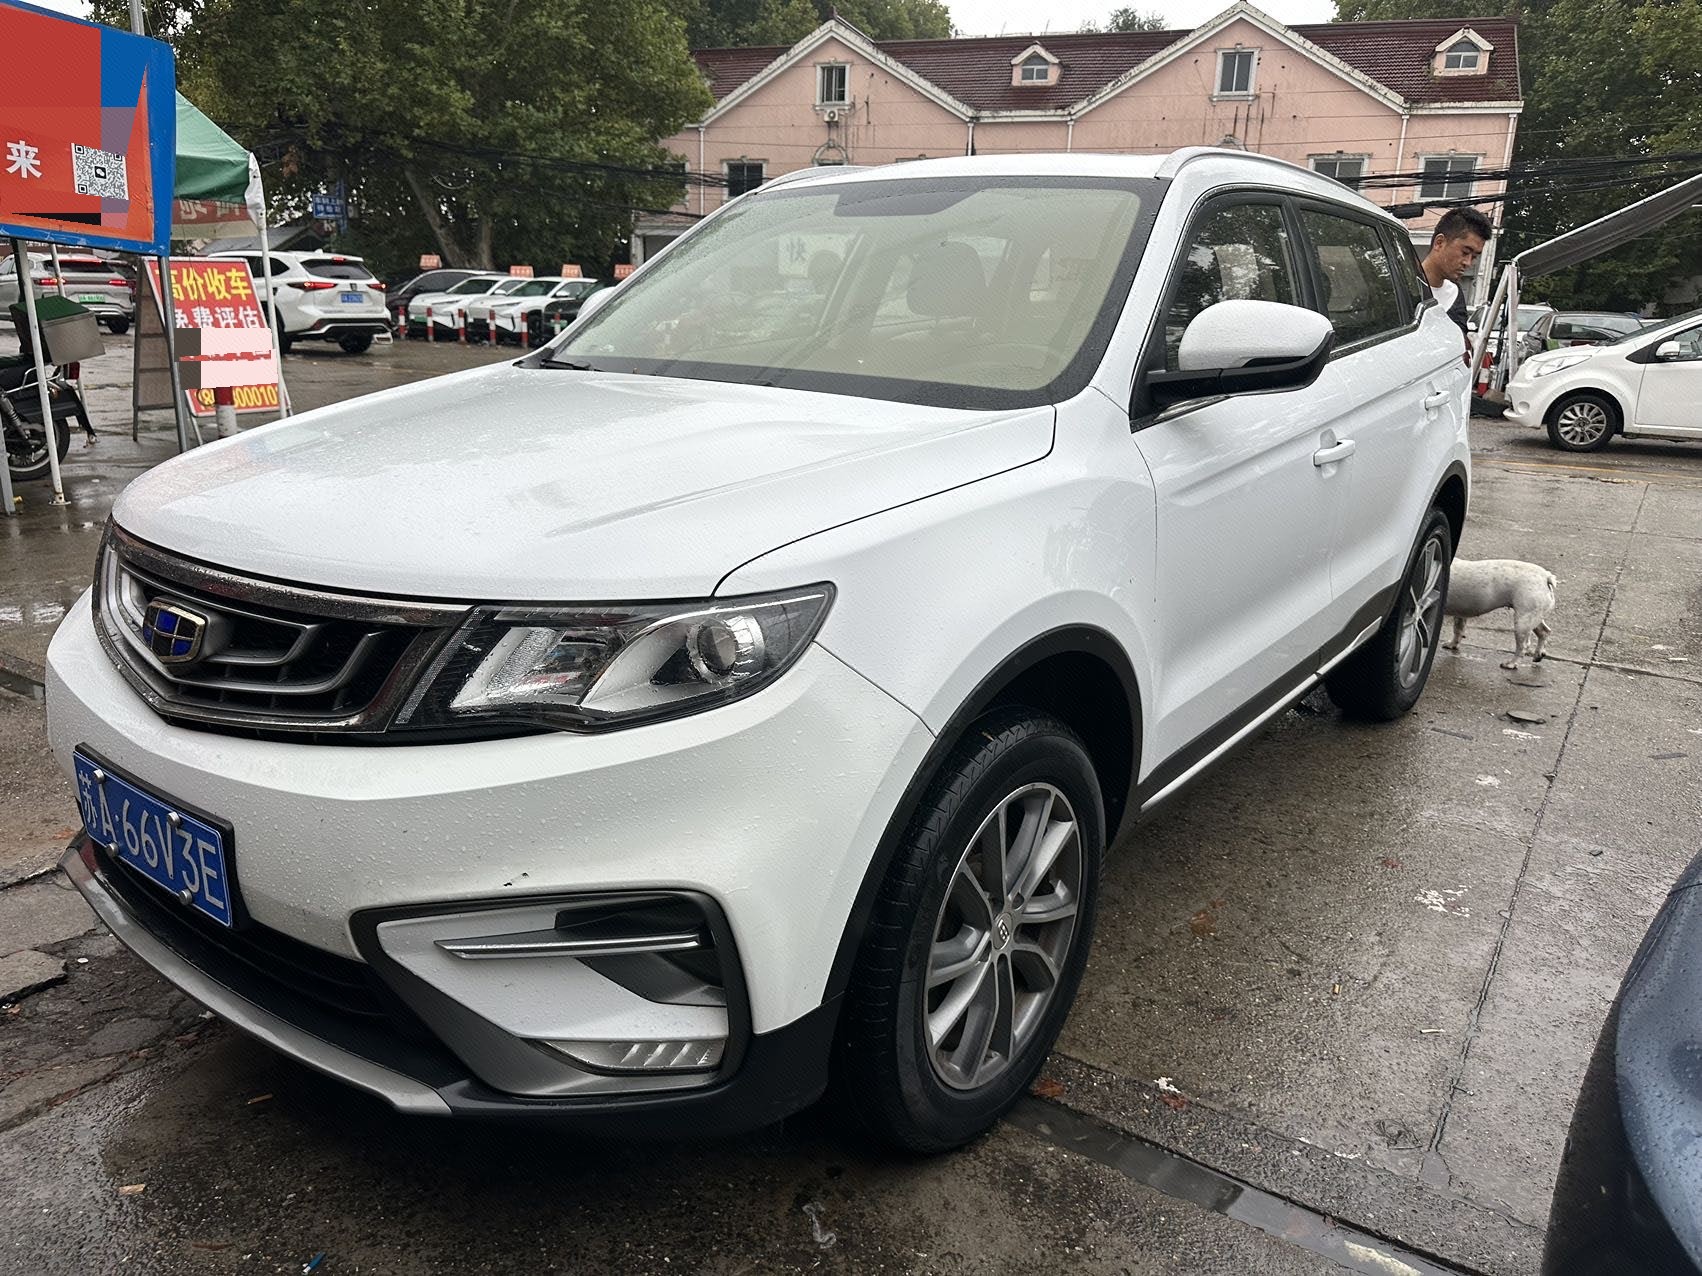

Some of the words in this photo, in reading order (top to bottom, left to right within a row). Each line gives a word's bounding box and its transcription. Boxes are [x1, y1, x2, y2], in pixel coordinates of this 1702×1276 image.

[6, 140, 42, 178] 来
[157, 267, 251, 301] 高价收车
